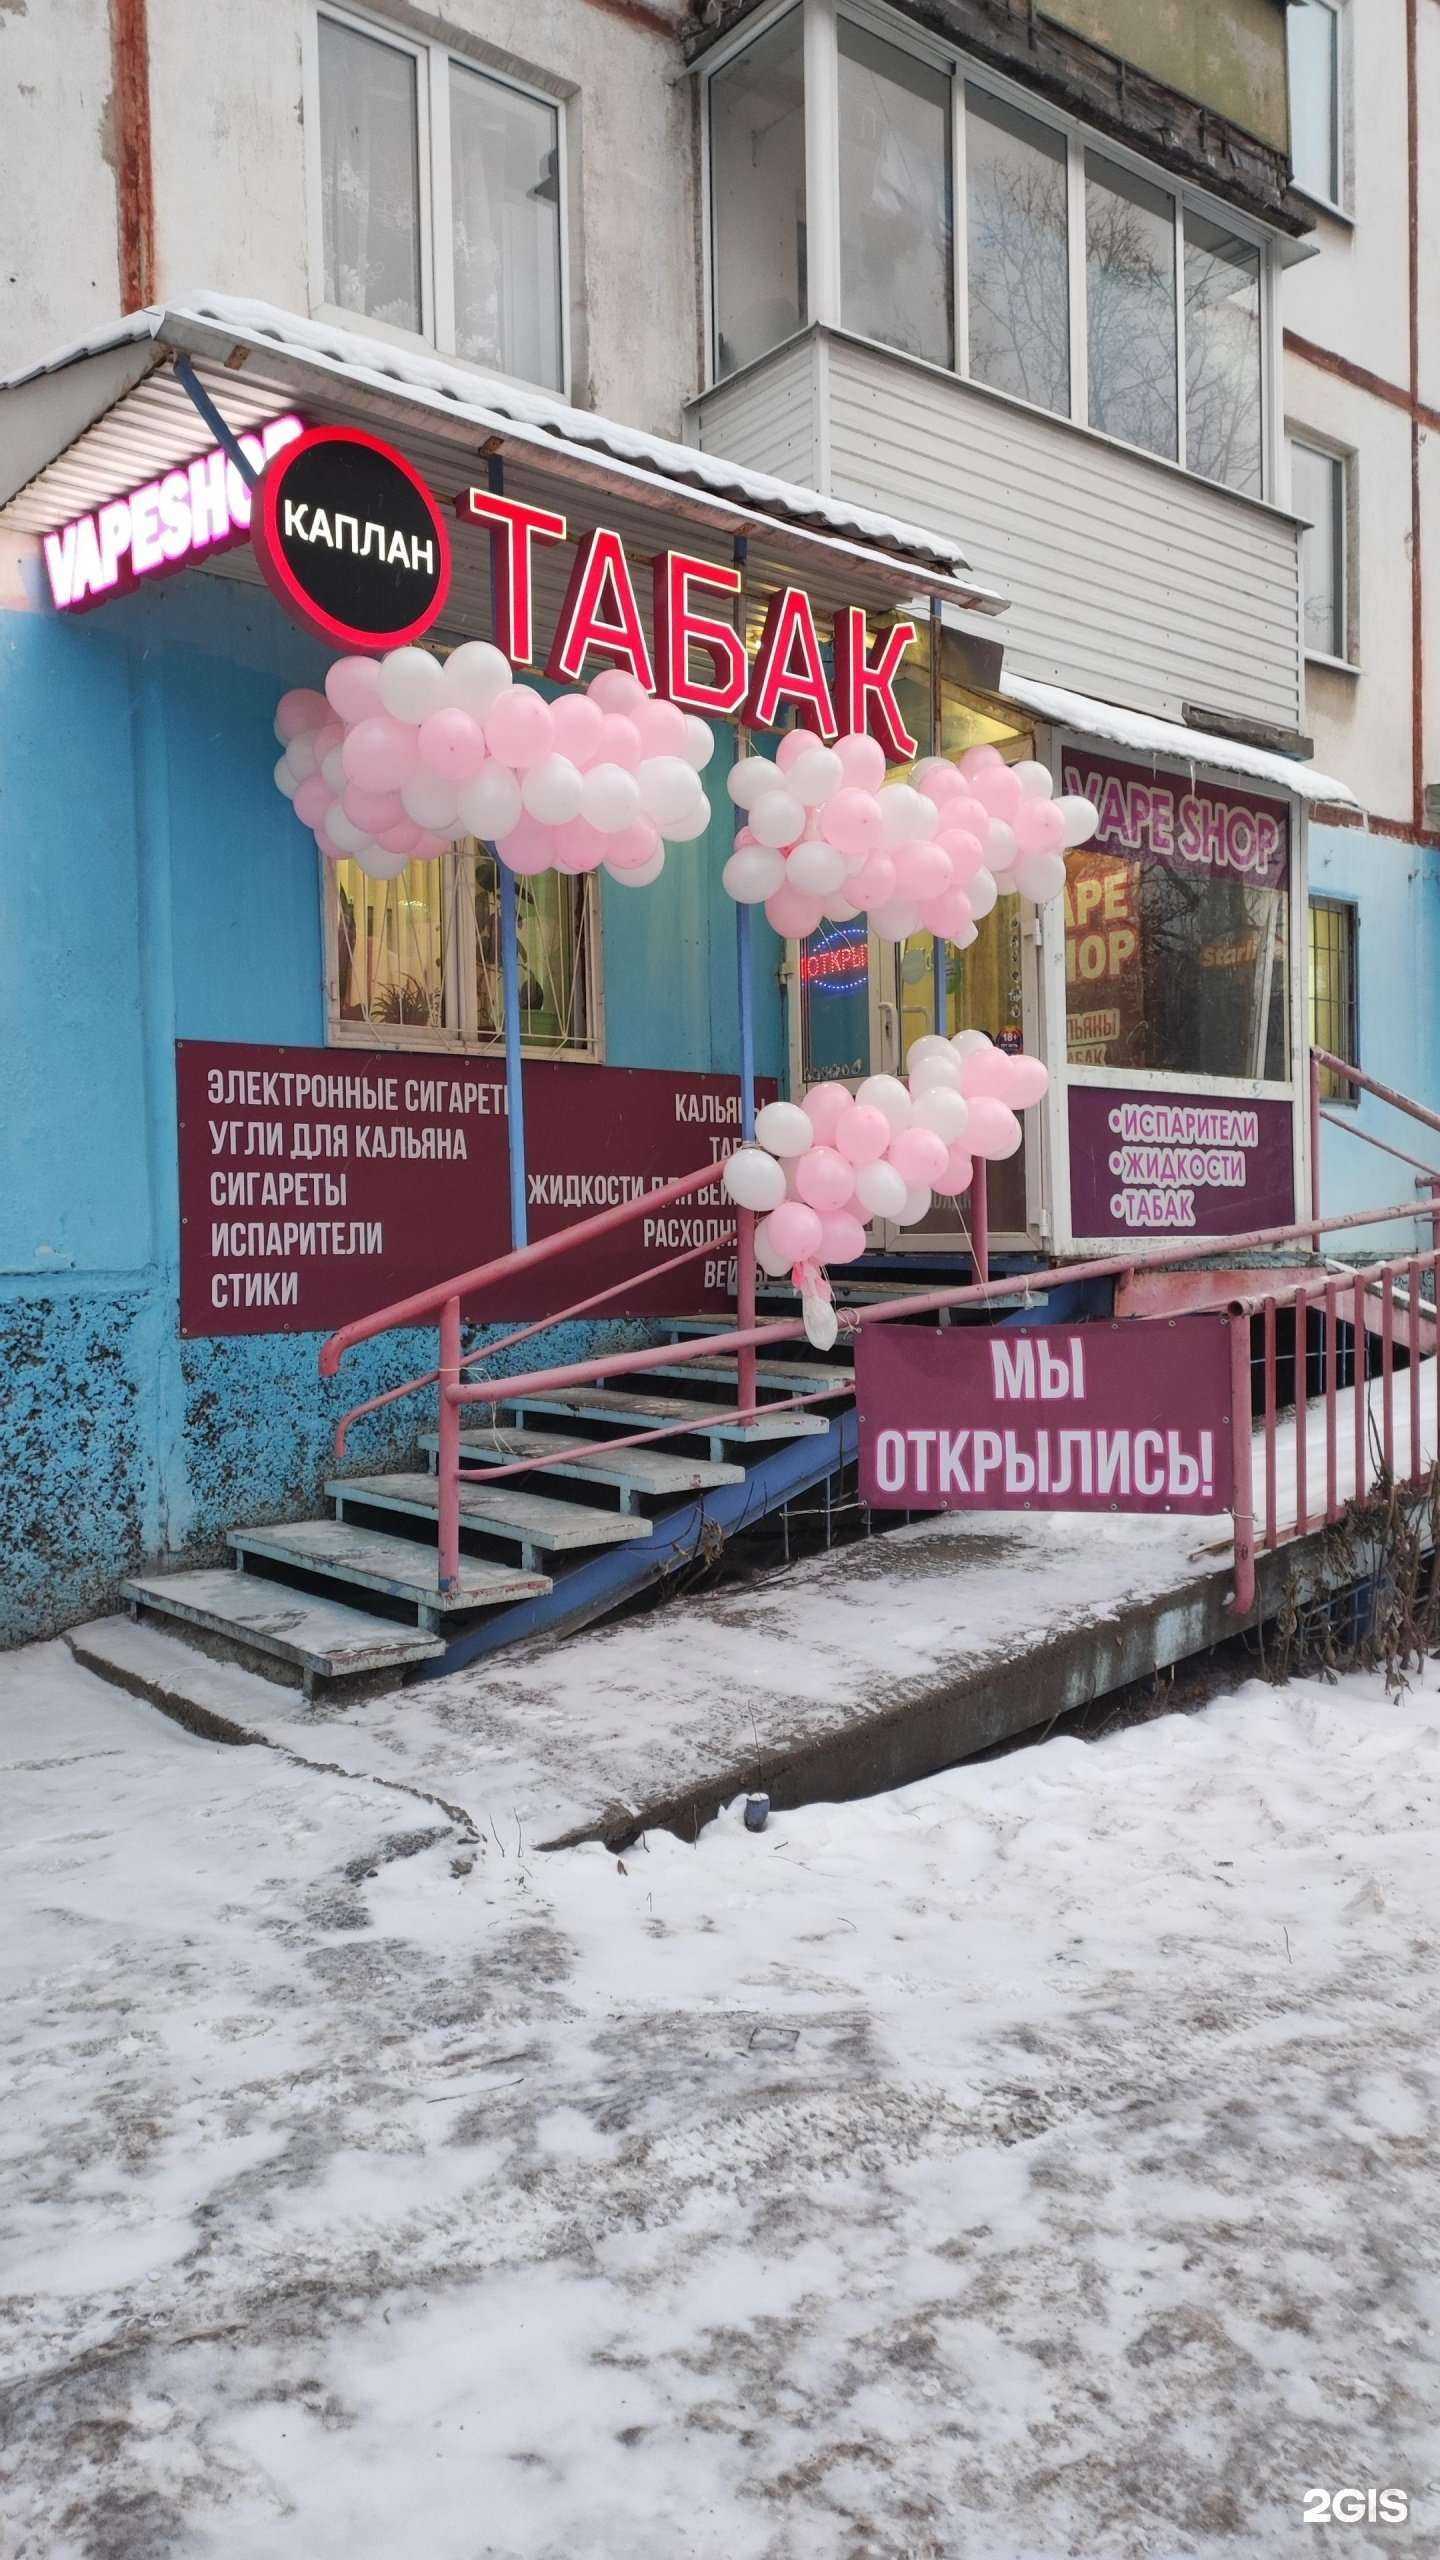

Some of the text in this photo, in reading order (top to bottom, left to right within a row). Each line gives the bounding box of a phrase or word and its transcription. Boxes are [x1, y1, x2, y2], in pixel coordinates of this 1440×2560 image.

[284, 500, 433, 575] КАПЛАН
[466, 487, 918, 760] ТАБАК
[1178, 794, 1279, 875] SHOP
[1066, 872, 1128, 926] PE
[808, 945, 867, 977] ОТКРЫ
[1066, 929, 1135, 982] OP
[207, 1068, 509, 1115] ЭЛЕКТРОННЫЕ СИГАРЕТ
[208, 1120, 467, 1160] УГЛИ ДЛЯ КАЛЬЯНА
[1122, 1107, 1257, 1144] ИСПАРИТЕЛИ
[1123, 1149, 1244, 1185] ЖИДКОСТИ
[210, 1171, 347, 1206] СИГАРЕТЫ
[528, 1174, 644, 1208] ЖИДКОСТИ
[1124, 1192, 1193, 1223] ТАБАК
[211, 1222, 383, 1256] ИСПАРИТЕЛИ
[211, 1271, 299, 1308] СТИКИ
[989, 1336, 1086, 1400] МЫ
[875, 1429, 1215, 1498] ОТКРЫЛИСЬ!
